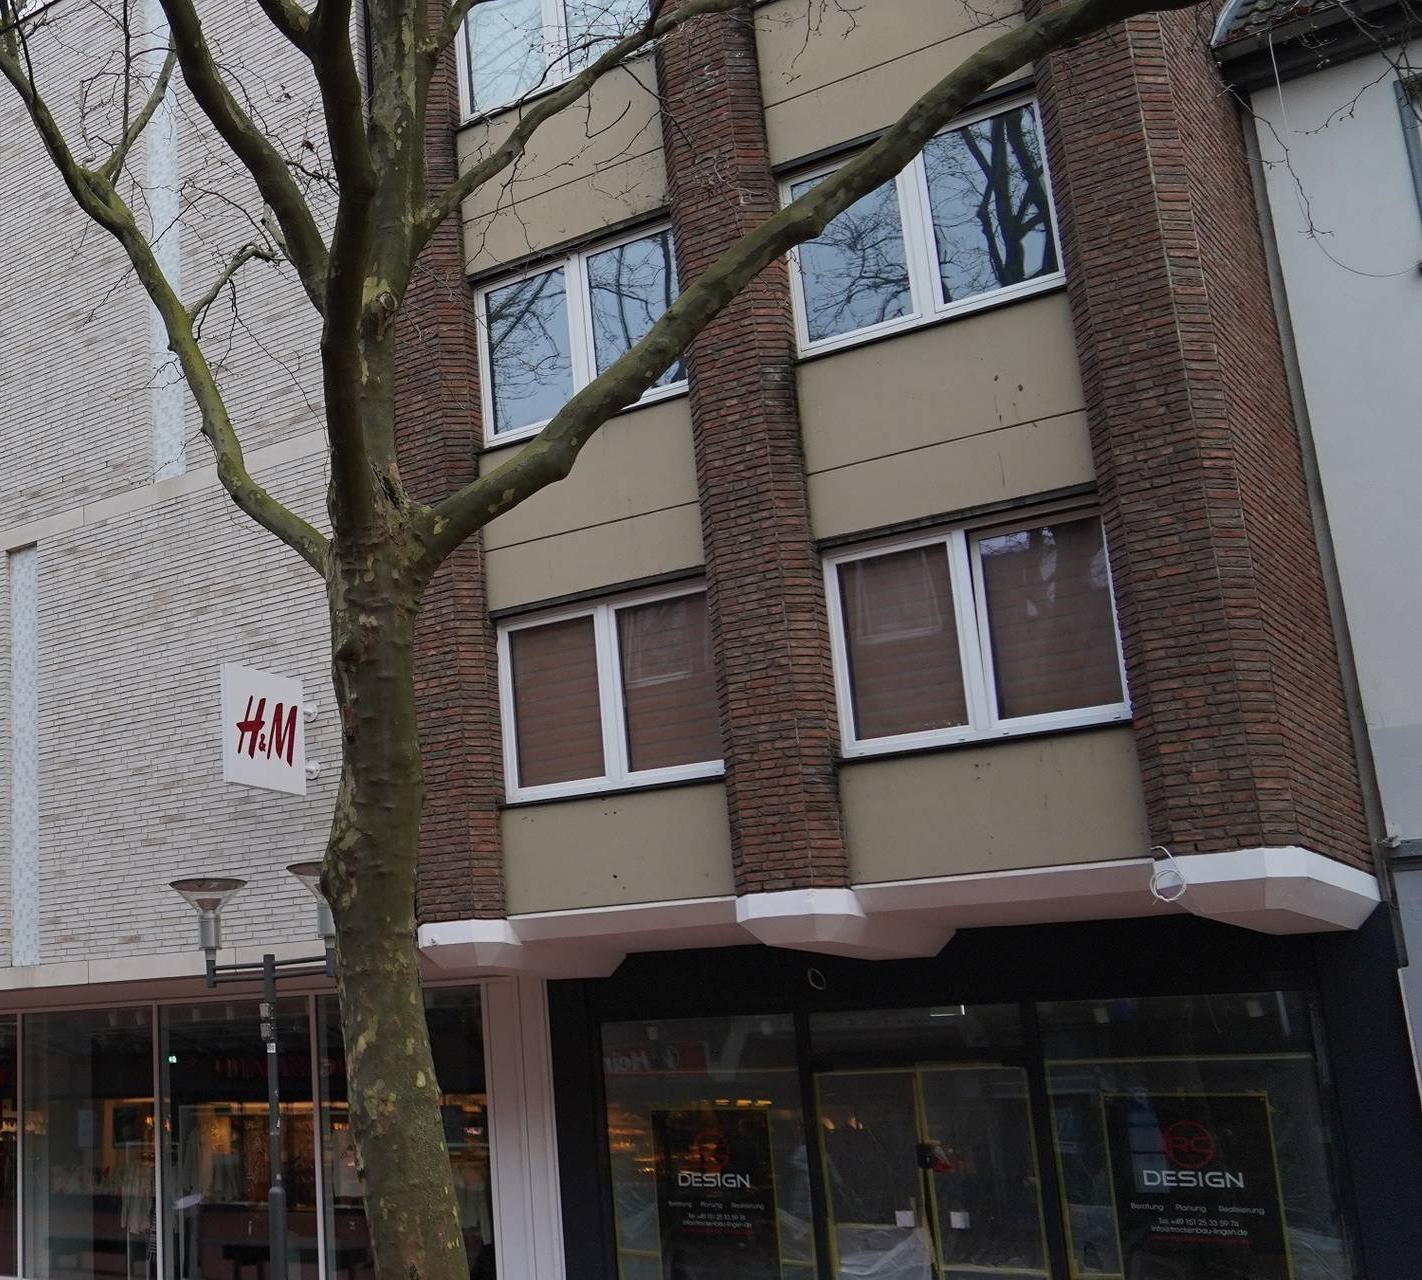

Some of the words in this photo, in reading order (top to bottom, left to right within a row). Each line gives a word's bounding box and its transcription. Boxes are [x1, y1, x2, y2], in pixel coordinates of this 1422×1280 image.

[236, 695, 298, 768] H&M
[677, 1171, 752, 1189] DESIGN
[1143, 1170, 1244, 1188] DESIGN
[1131, 1202, 1164, 1211] Beratung
[1176, 1204, 1207, 1213] Planung
